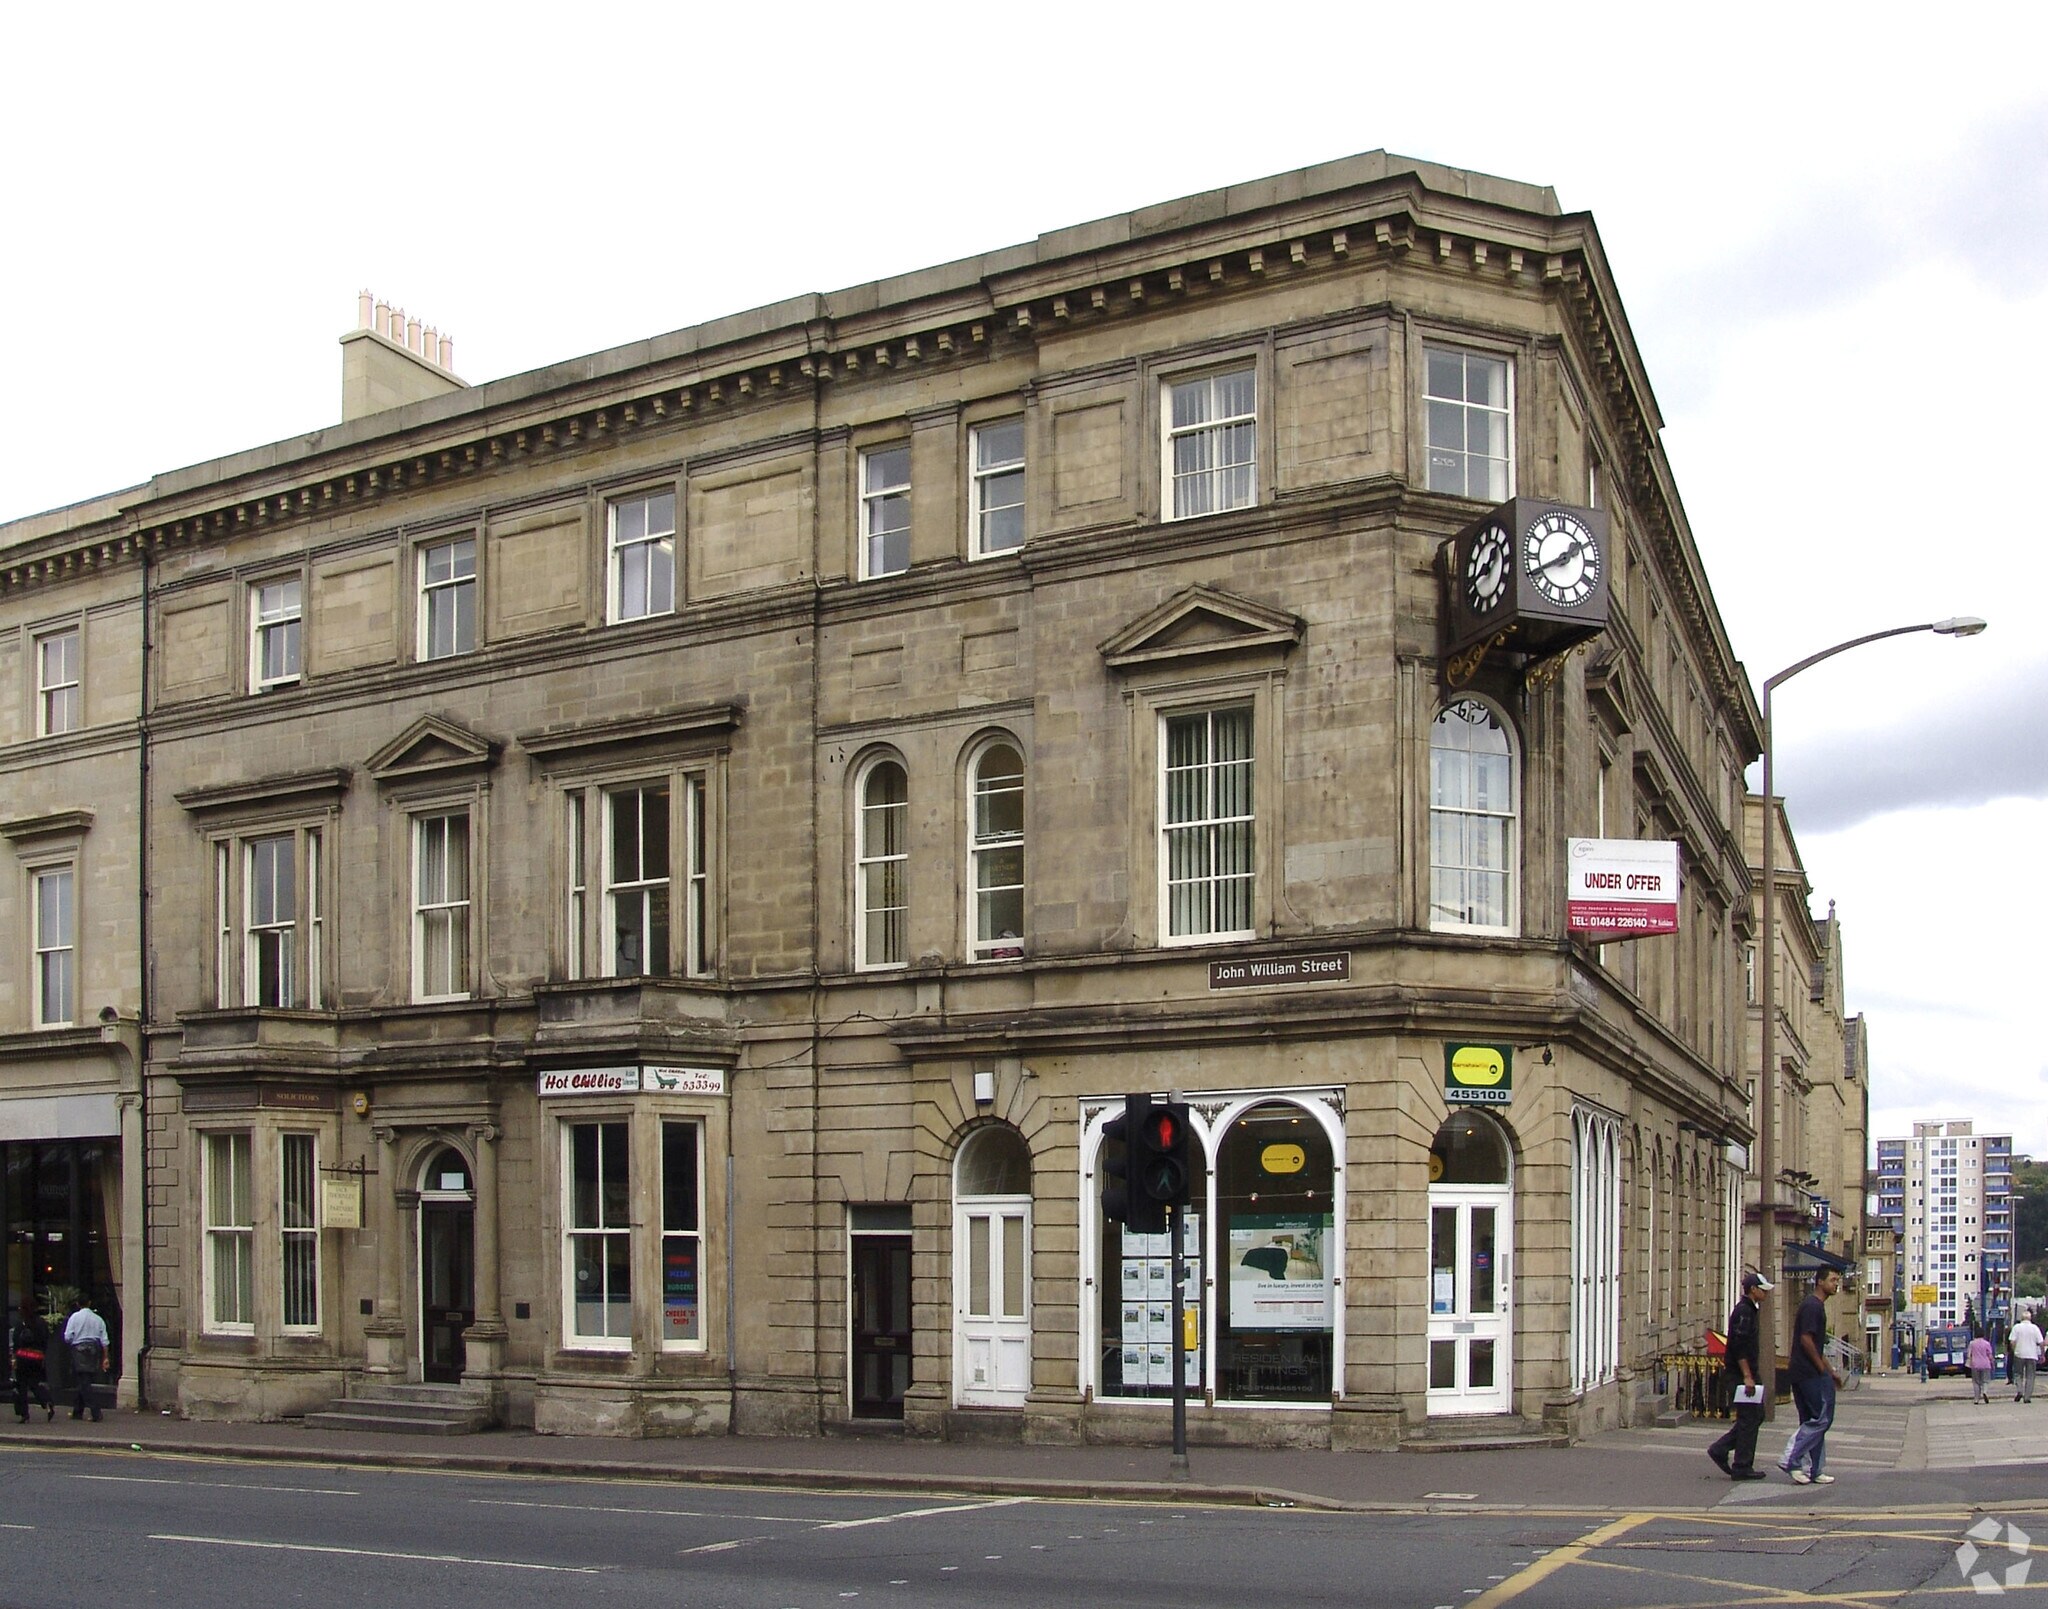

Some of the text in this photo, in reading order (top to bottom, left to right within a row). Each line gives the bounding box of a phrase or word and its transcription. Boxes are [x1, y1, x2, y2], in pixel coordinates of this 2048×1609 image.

[1584, 872, 1661, 891] UNDER OFFER
[1571, 916, 1588, 926] TEL:
[1590, 917, 1616, 927] 01484
[1617, 917, 1647, 928] 226140
[1216, 958, 1342, 980] John William Street
[545, 1075, 568, 1089] Hot
[572, 1074, 622, 1089] Chillies
[682, 1080, 721, 1091] 533399
[276, 1092, 320, 1101] SOLICITORS
[1451, 1090, 1507, 1100] 455100
[1231, 1353, 1320, 1364] RESIDENTIAL
[1242, 1364, 1308, 1375] LETTINGS
